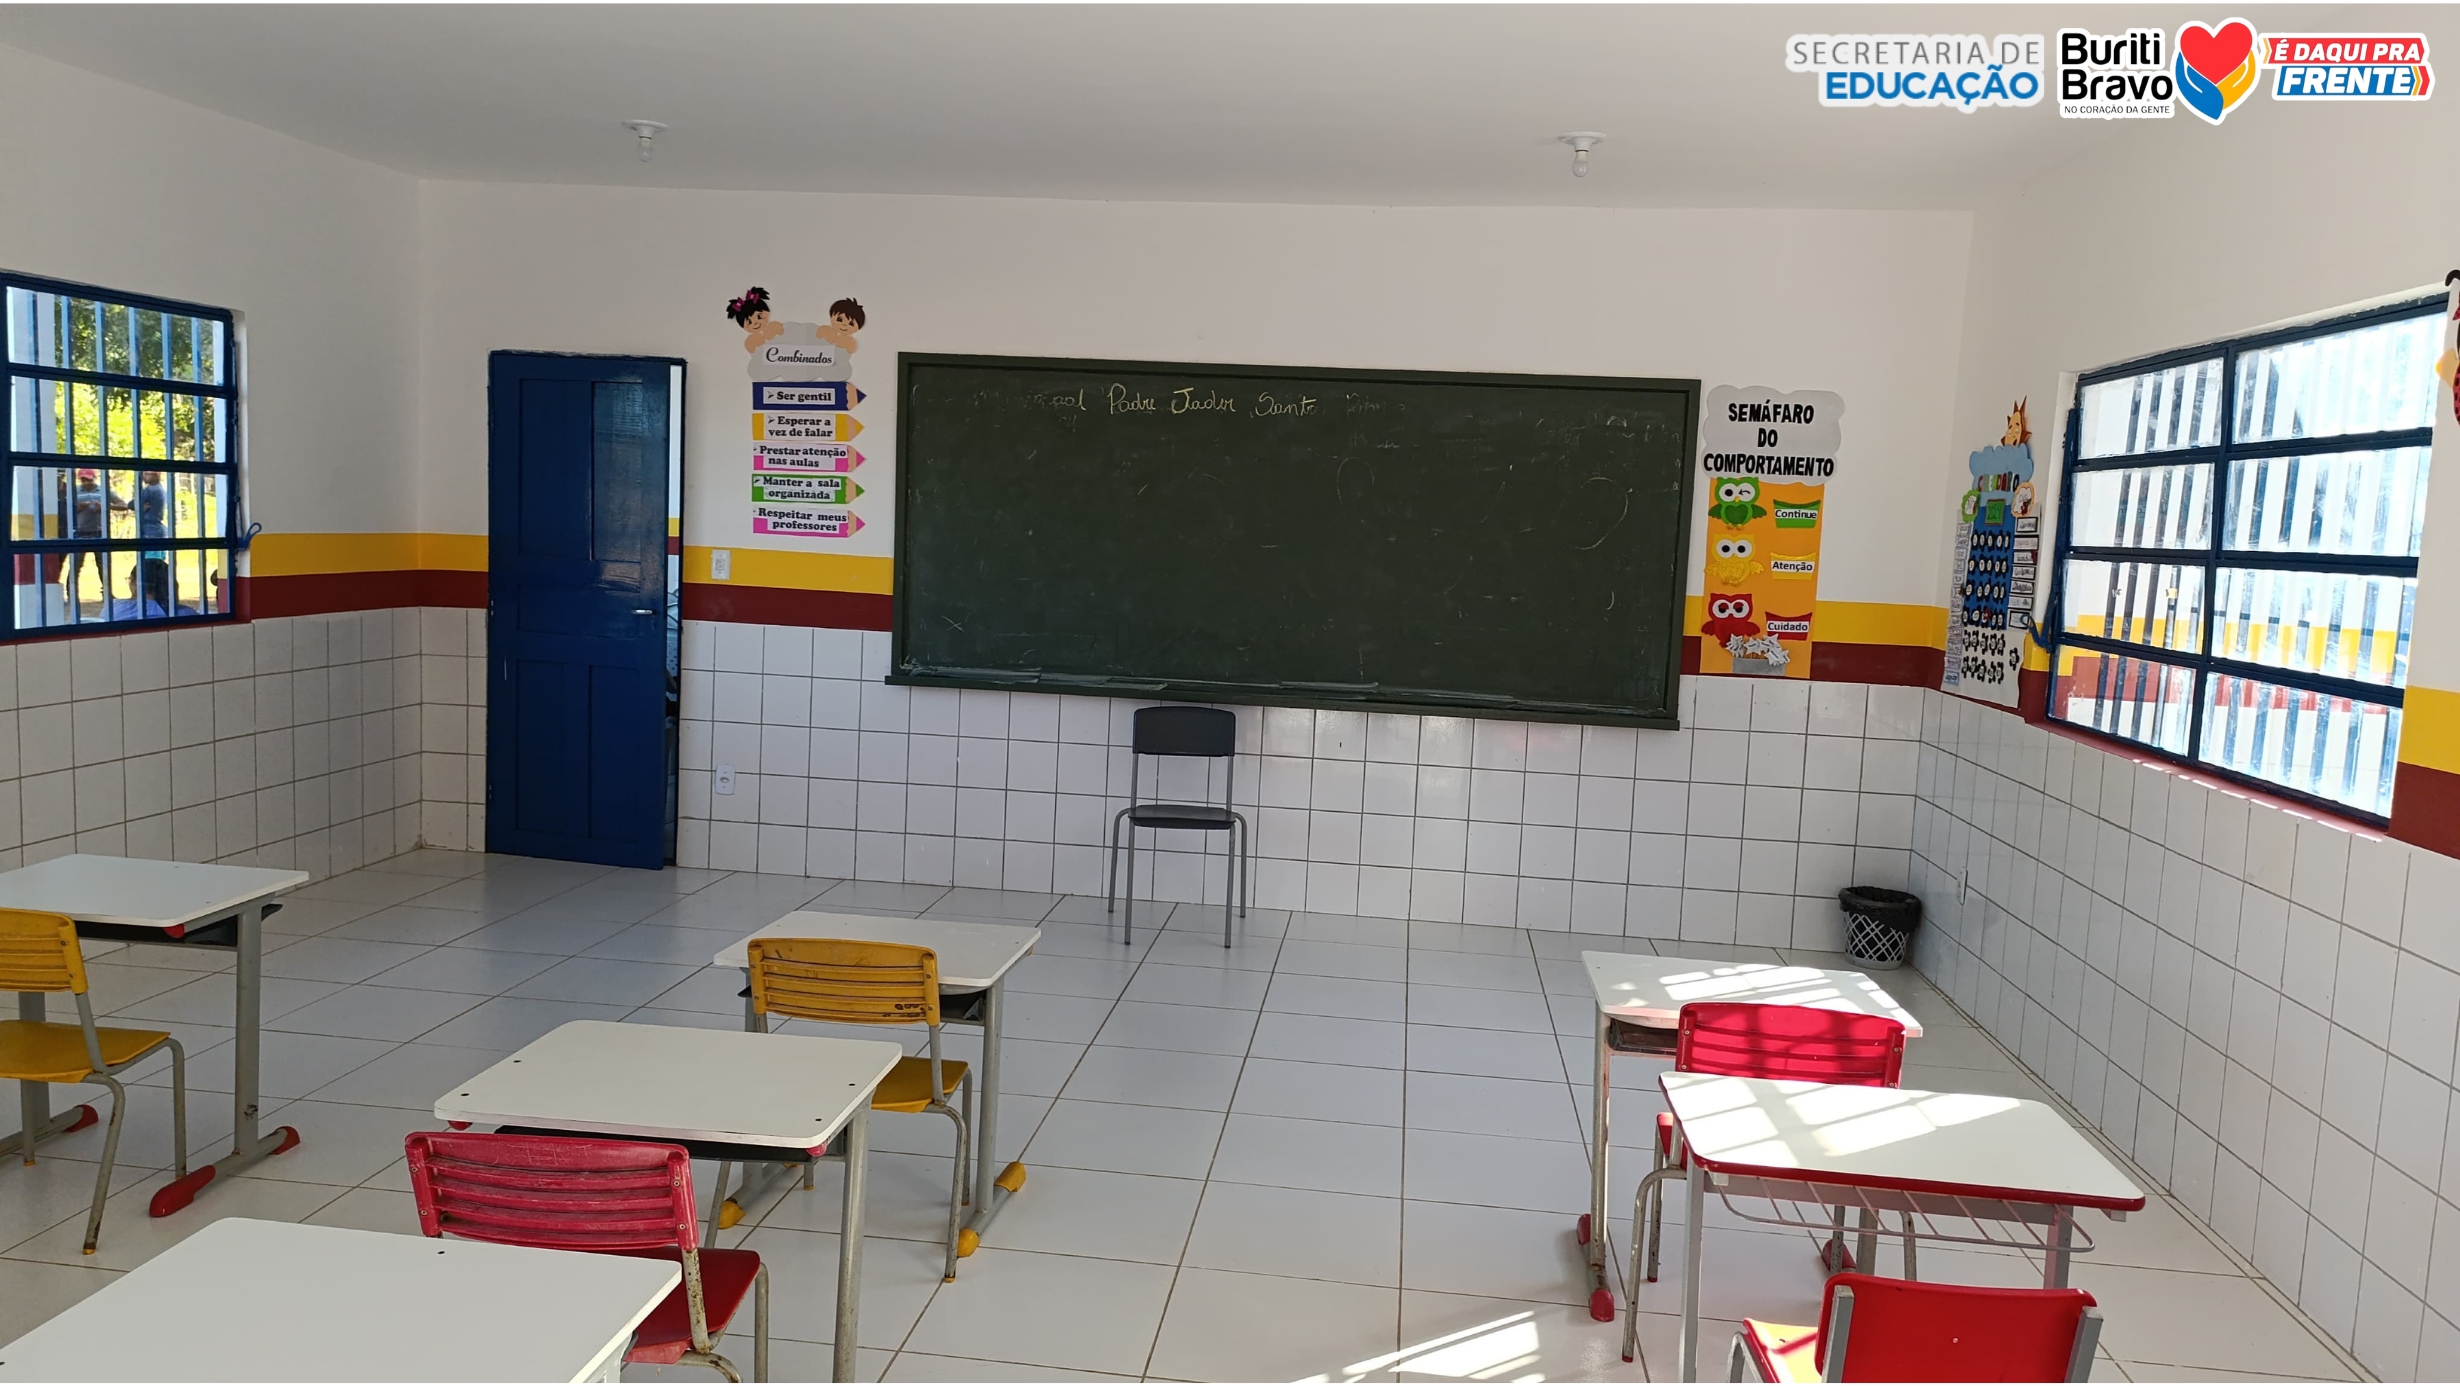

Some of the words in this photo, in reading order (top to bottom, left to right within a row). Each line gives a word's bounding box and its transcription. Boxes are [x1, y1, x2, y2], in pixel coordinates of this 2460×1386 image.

[766, 346, 833, 364] Combinados
[777, 391, 796, 401] Ser
[798, 391, 832, 404] gentil
[1107, 383, 1157, 417] Padre
[1728, 399, 1814, 425] SEMÁFARO
[777, 416, 822, 429] Esperar
[824, 418, 831, 426] a
[768, 429, 787, 438] vez
[788, 428, 802, 438] de
[804, 428, 833, 438] falar
[1758, 428, 1778, 447] DO
[759, 446, 801, 457] Prestar
[802, 447, 846, 460] atenção
[768, 457, 787, 466] nas
[790, 458, 820, 467] aulas
[1704, 453, 1834, 477] COMPORTAMENTO
[763, 476, 803, 487] Manter
[806, 479, 812, 487] a
[818, 478, 840, 488] sala
[768, 489, 830, 501] organizada
[758, 508, 812, 521] Respeitar
[818, 513, 847, 522] meus
[1775, 508, 1817, 520] Continue
[772, 520, 837, 532] professores
[1772, 561, 1813, 573] Atenção
[1767, 622, 1808, 632] Cuidado
